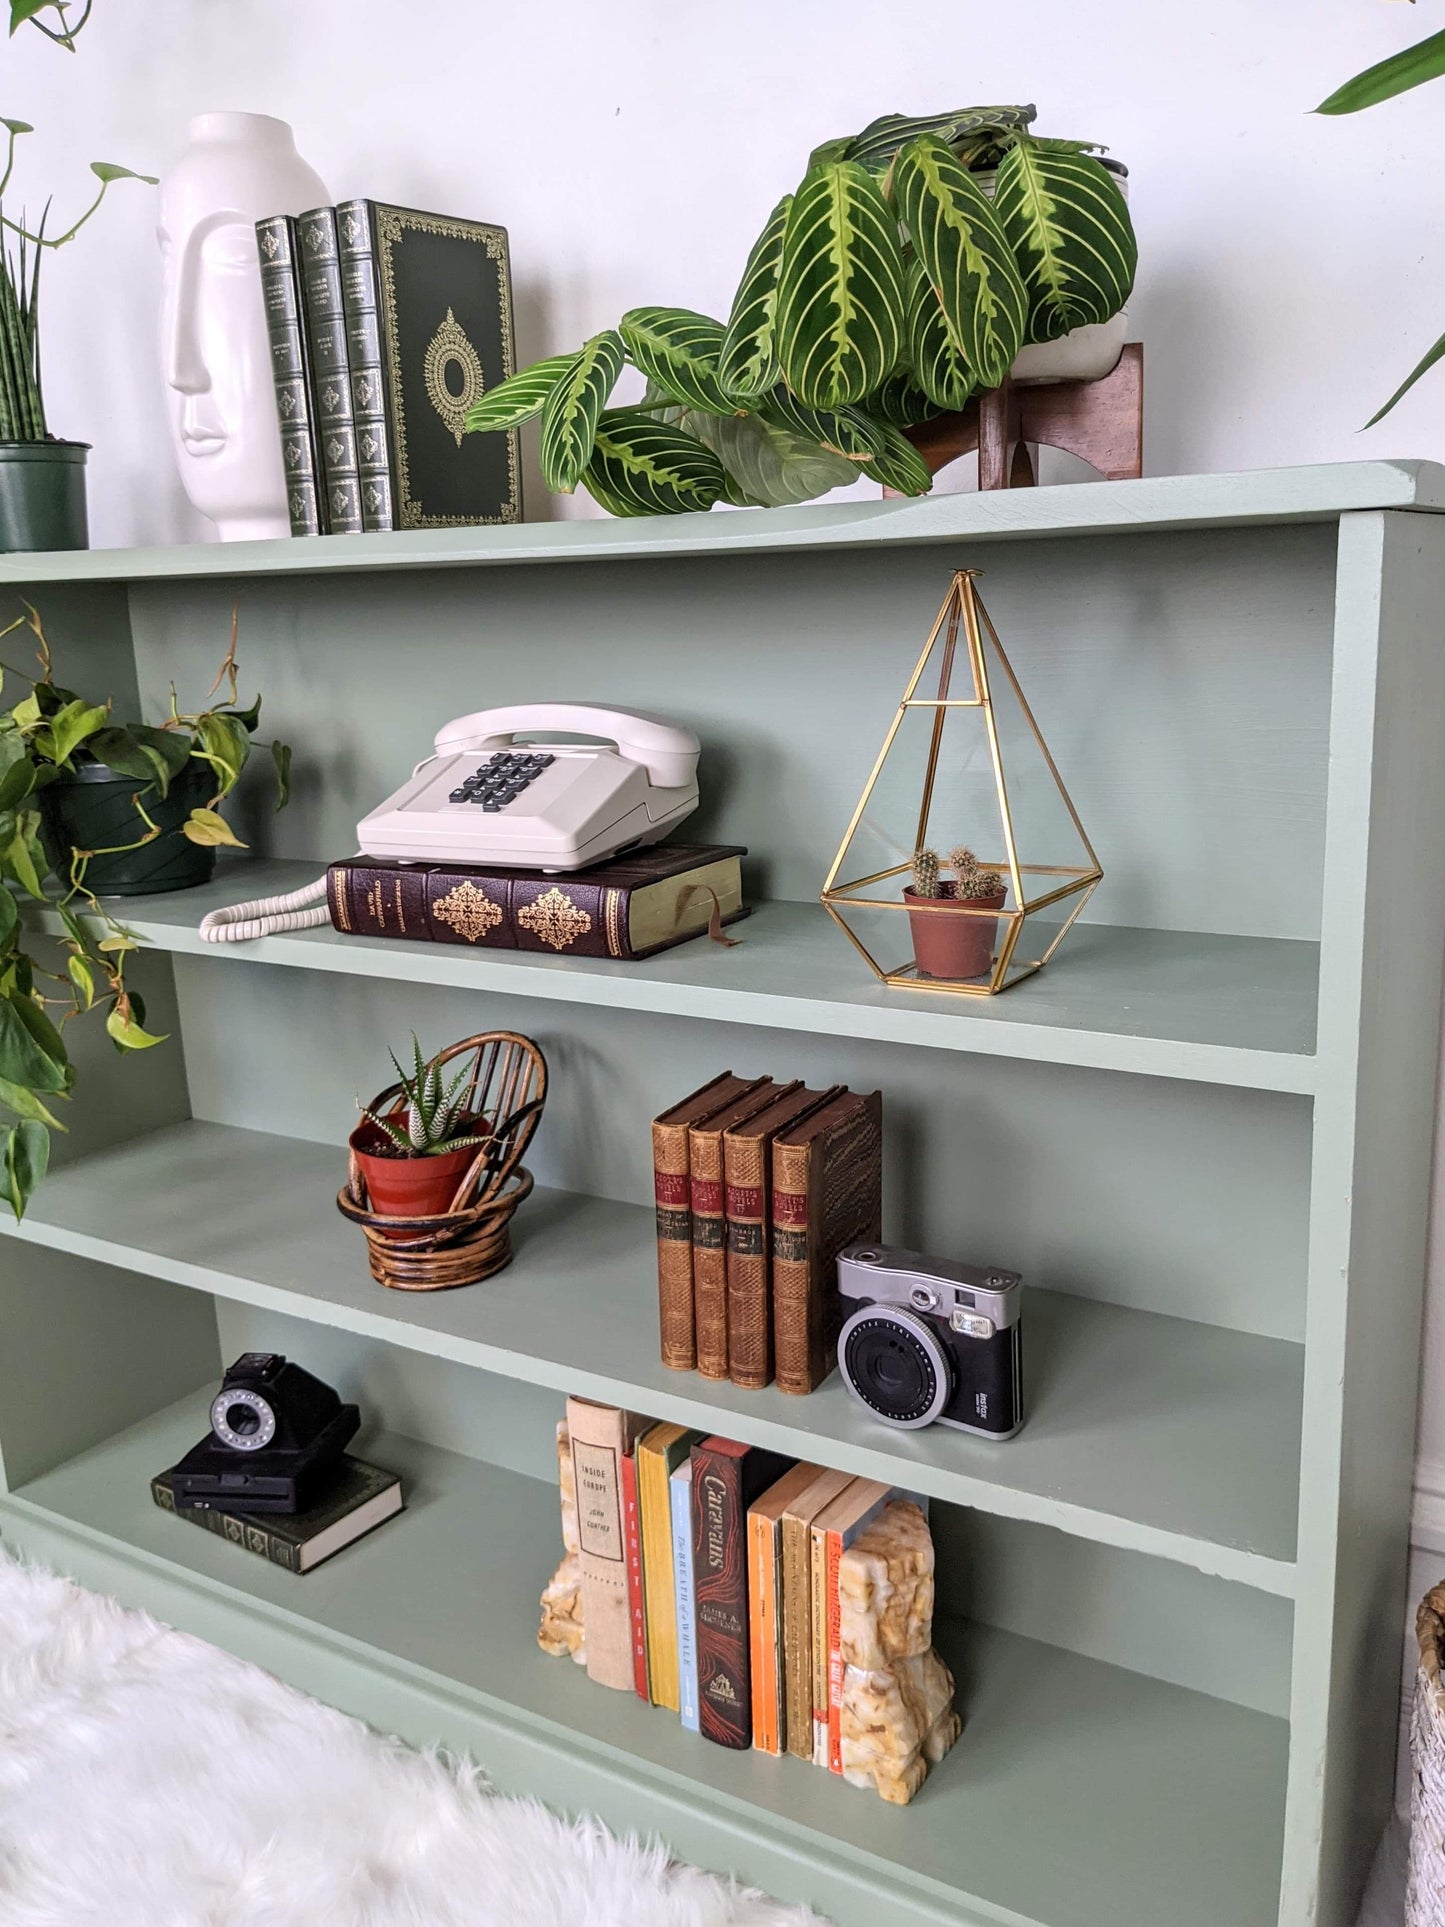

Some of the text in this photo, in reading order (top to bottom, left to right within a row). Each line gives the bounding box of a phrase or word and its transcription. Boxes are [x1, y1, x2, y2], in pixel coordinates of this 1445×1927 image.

[980, 1392, 988, 1420] instax
[582, 1464, 606, 1479] INSIDE
[583, 1479, 607, 1493] EUROPE
[704, 1475, 727, 1569] Caravans
[629, 1502, 644, 1656] FIRST AID
[679, 1552, 689, 1602] BREATH
[830, 1587, 841, 1649] FITZGERALD
[682, 1623, 691, 1667] WHALE
